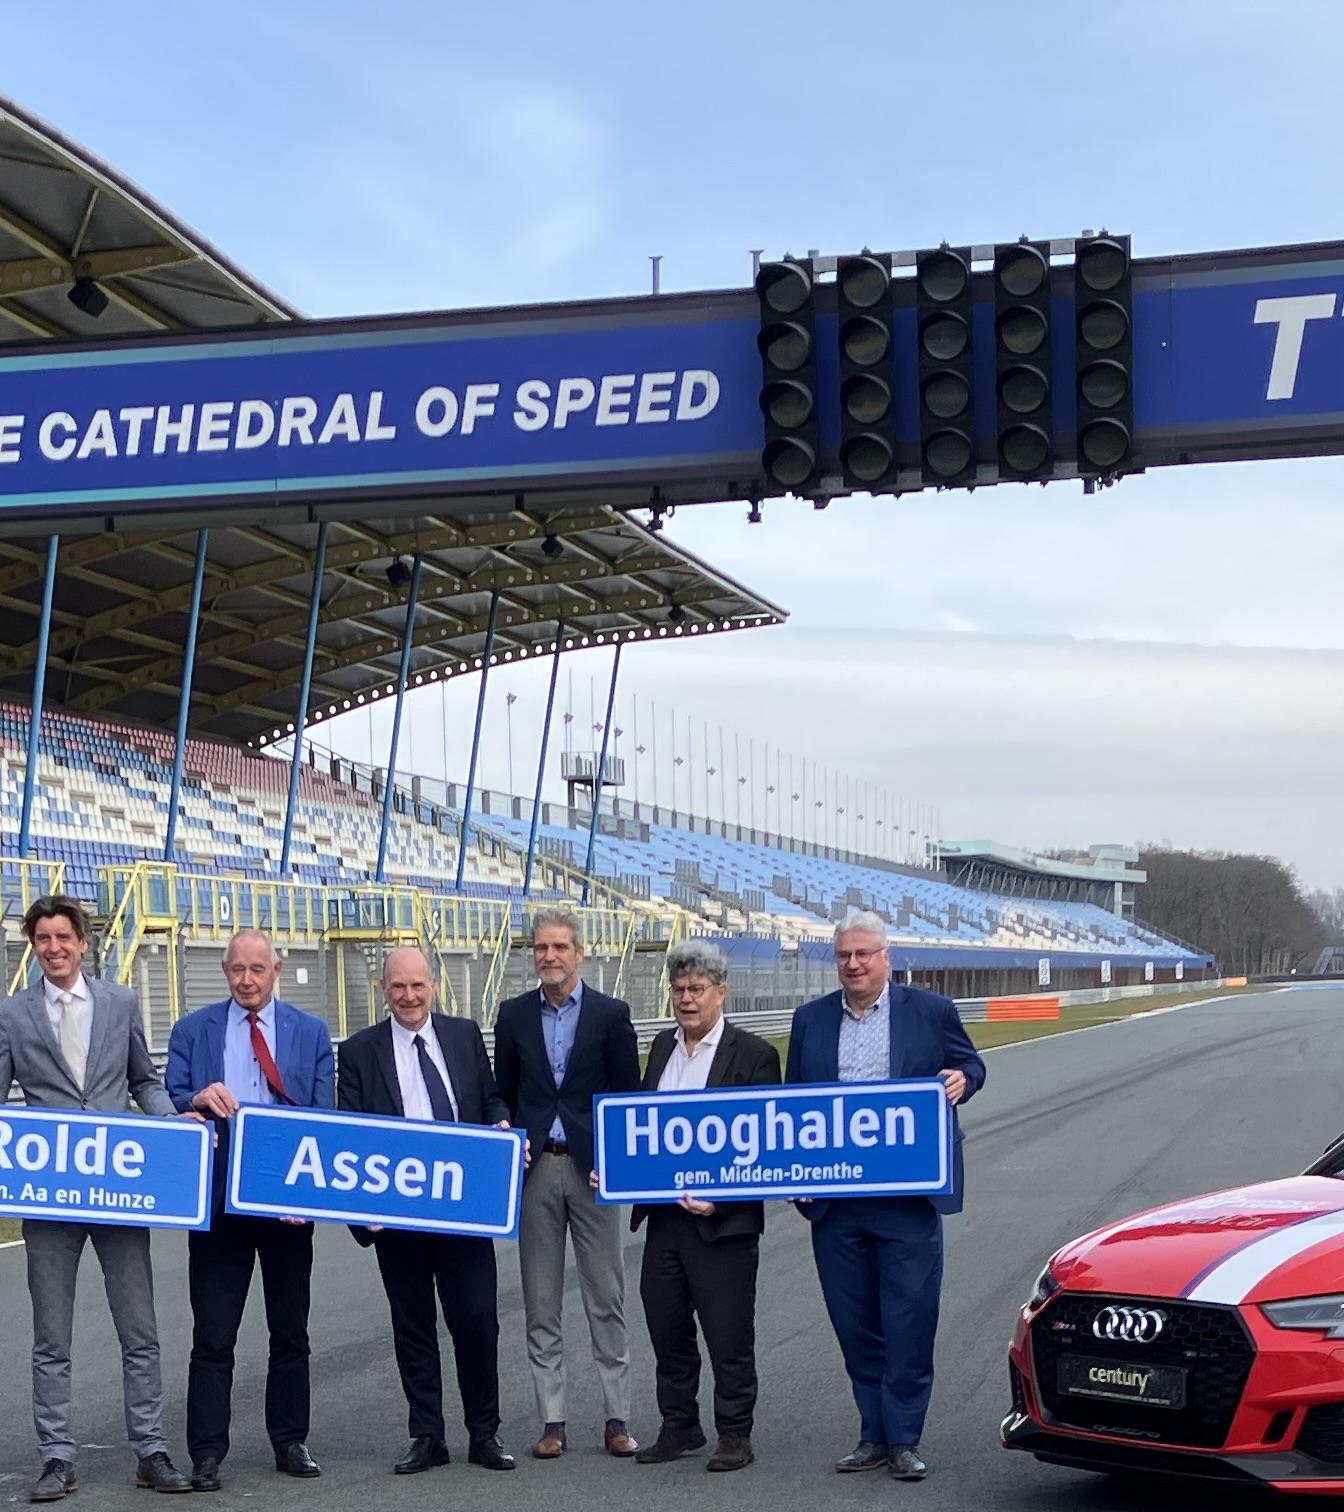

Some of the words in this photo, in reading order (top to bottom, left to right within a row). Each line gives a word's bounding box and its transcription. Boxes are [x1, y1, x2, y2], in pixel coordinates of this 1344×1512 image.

[38, 391, 397, 461] CATHEDRAL
[414, 384, 499, 438] OF
[513, 370, 721, 432] SPEED
[220, 896, 231, 920] D
[625, 1096, 916, 1166] Hooghalen
[284, 1136, 464, 1201] Assen
[674, 1169, 716, 1189] gem.
[720, 1162, 864, 1184] Midden-Drenthe
[20, 1183, 48, 1203] Aa
[55, 1189, 81, 1205] en
[89, 1187, 156, 1210] Hunze
[1088, 1366, 1151, 1395] century
